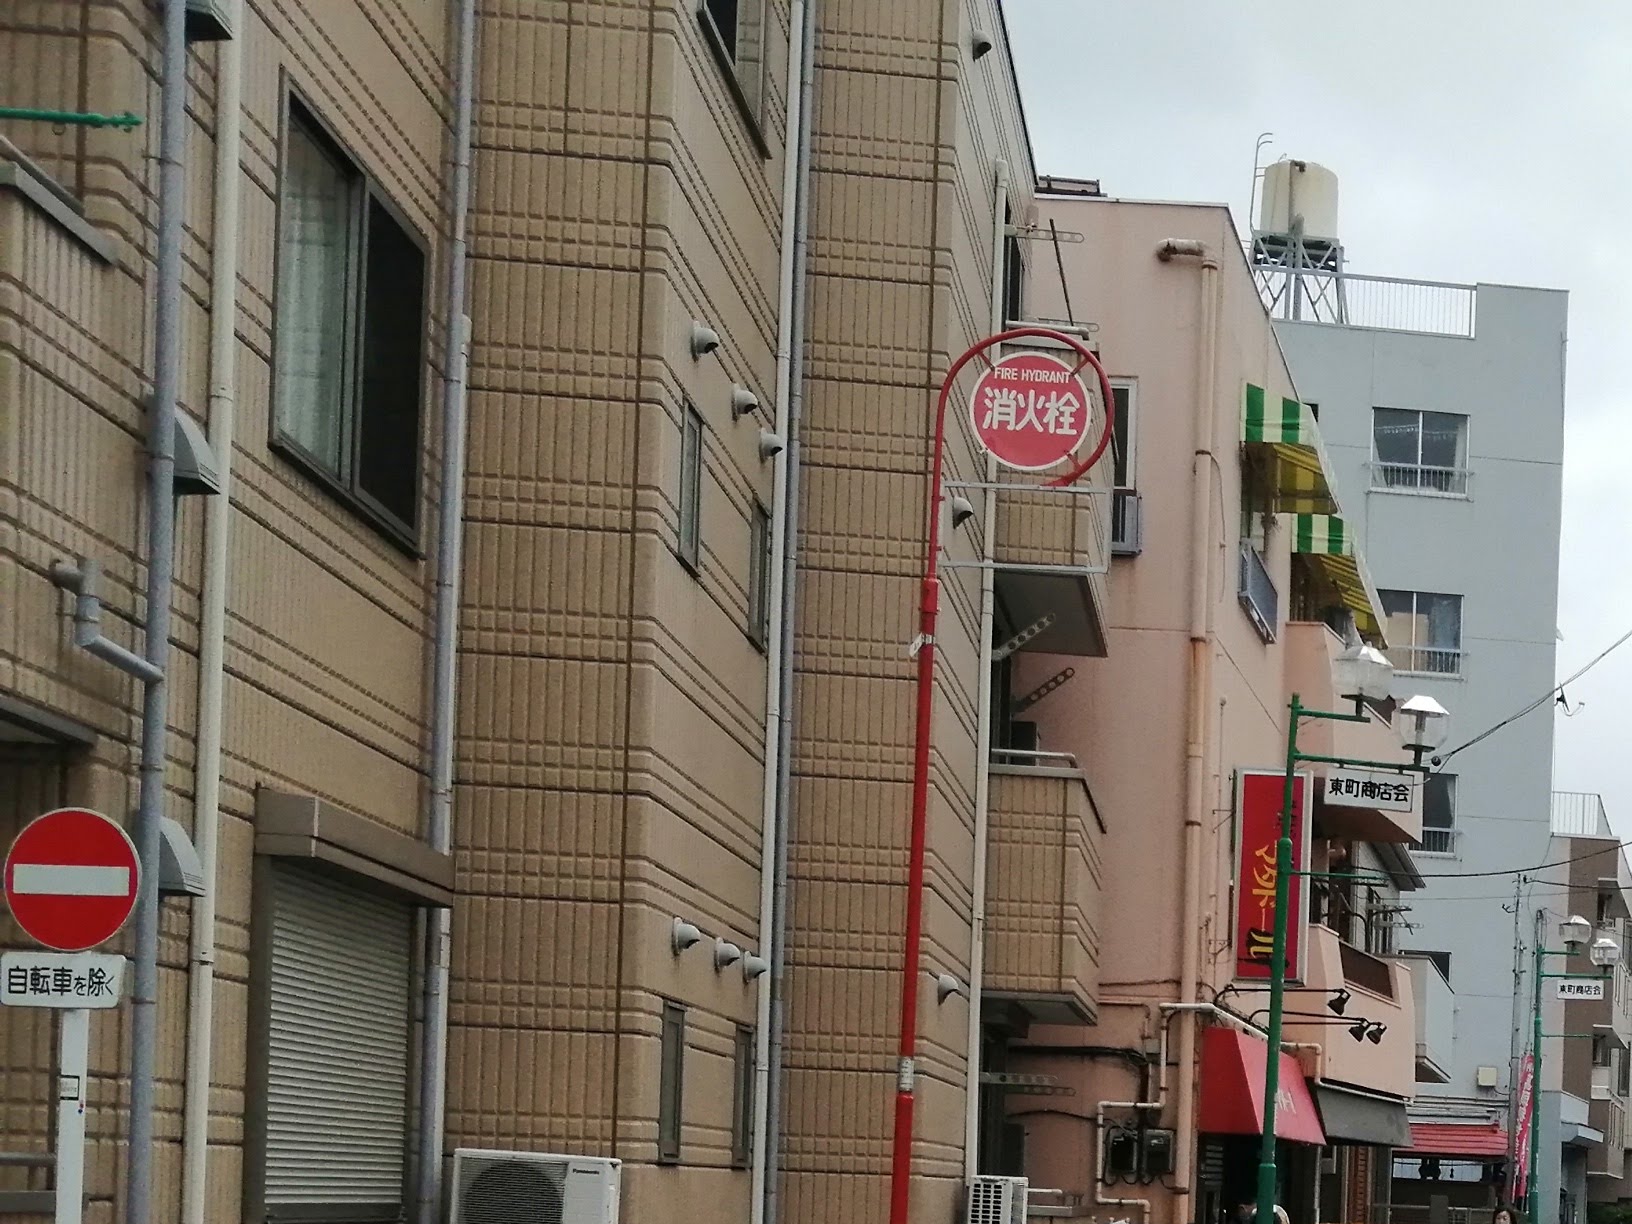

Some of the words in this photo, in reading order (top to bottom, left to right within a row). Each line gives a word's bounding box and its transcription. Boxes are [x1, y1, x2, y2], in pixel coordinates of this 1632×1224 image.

[994, 367, 1018, 380] FIRE
[1022, 368, 1071, 383] HYDRANT
[983, 387, 1080, 434] 消火栓
[1329, 777, 1410, 802] 東町商店会
[8, 966, 115, 997] 自転車を除く
